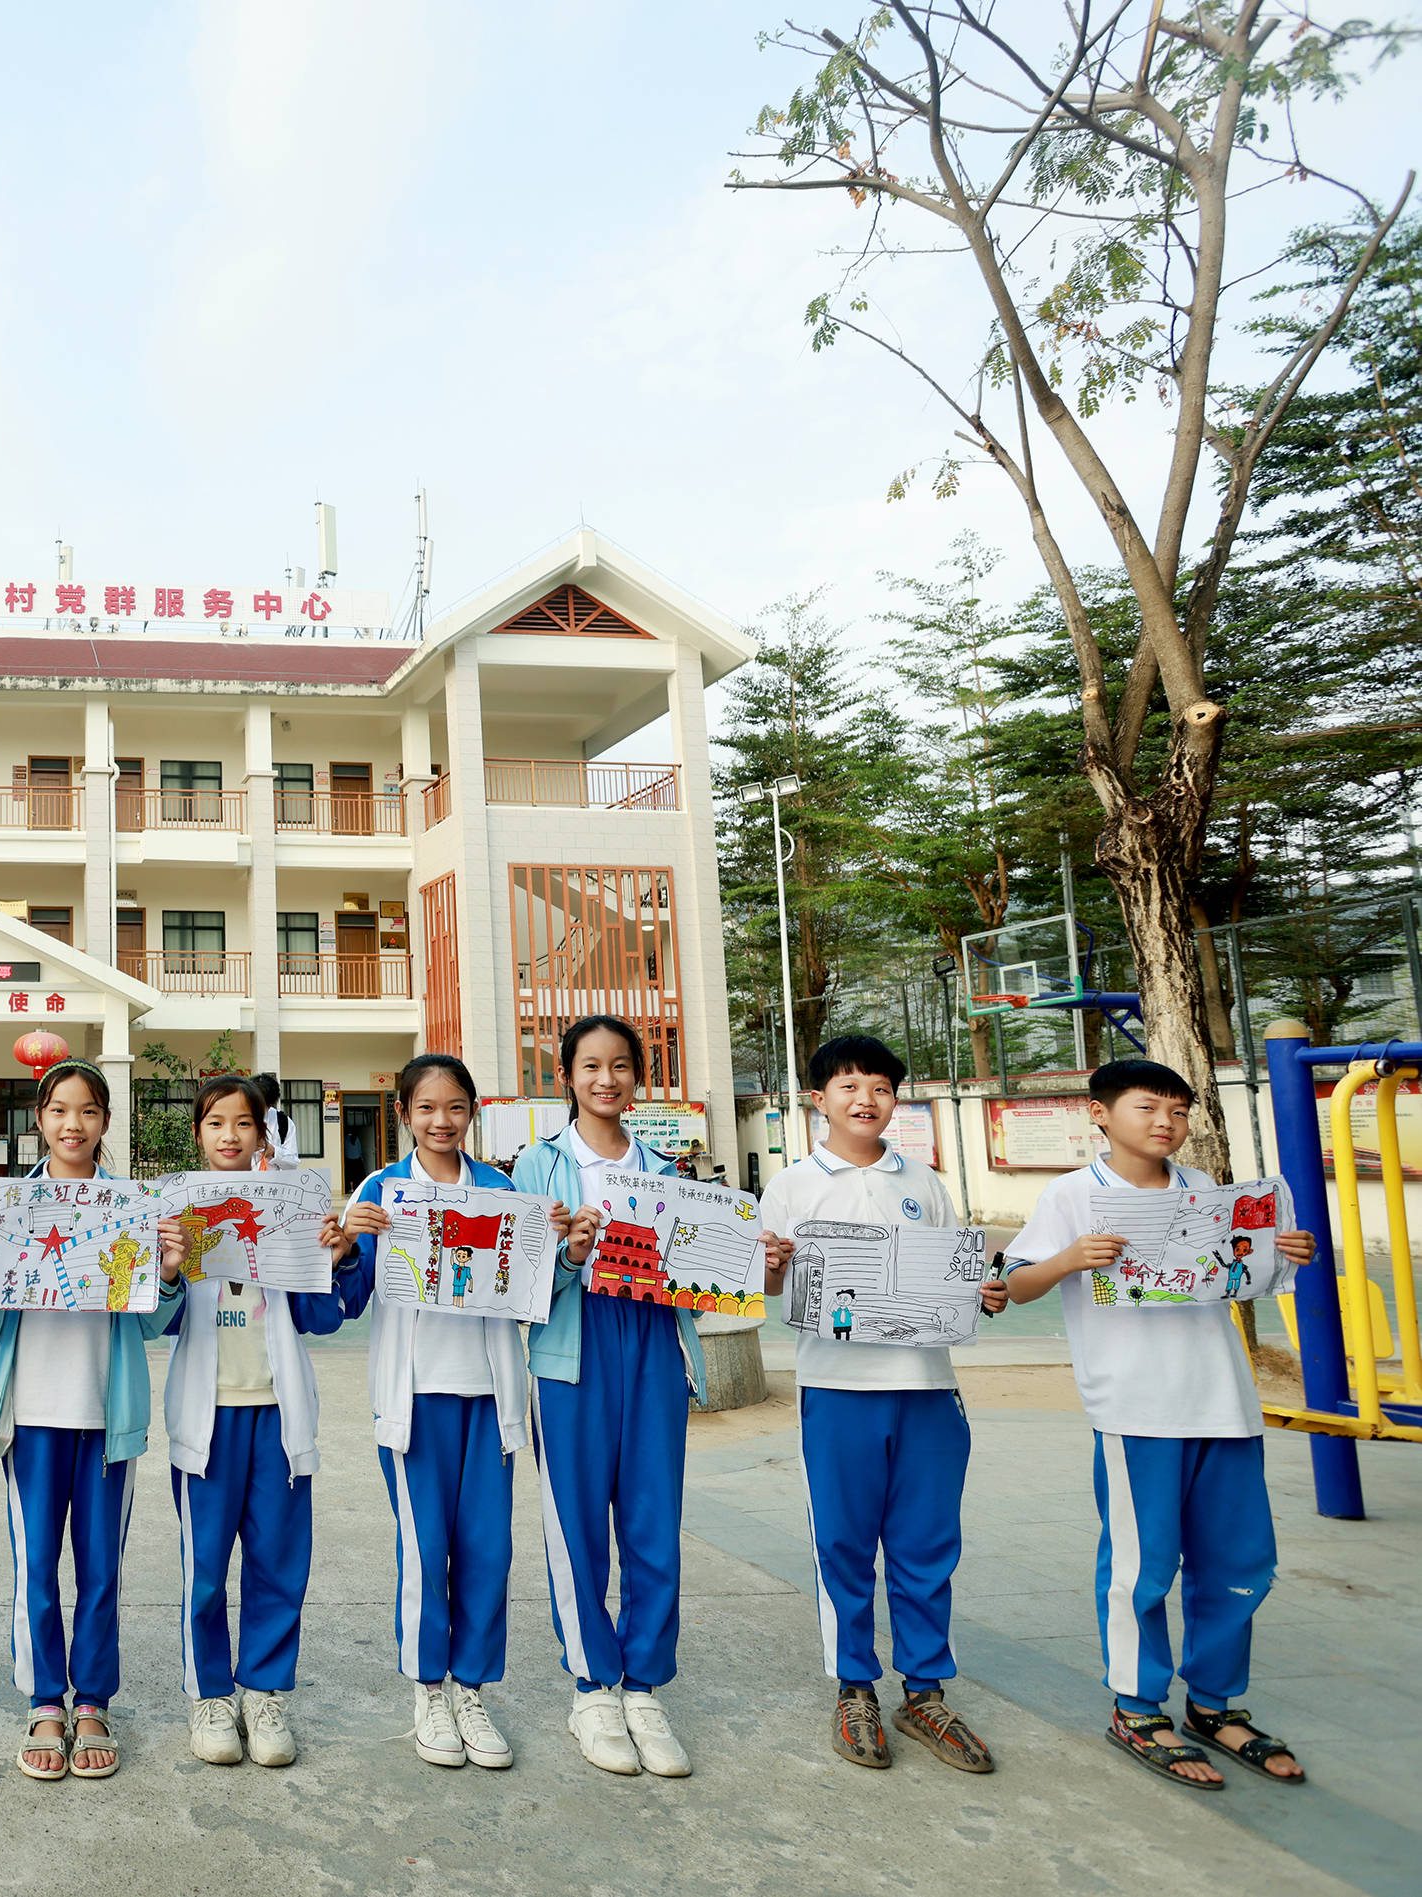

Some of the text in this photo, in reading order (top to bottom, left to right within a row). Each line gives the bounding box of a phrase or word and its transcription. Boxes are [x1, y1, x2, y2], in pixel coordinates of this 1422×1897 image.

[4, 1183, 130, 1209] 传承红色精神
[606, 1173, 733, 1206] 致敬革命先烈 传承红色精神
[944, 1227, 986, 1281] 加油
